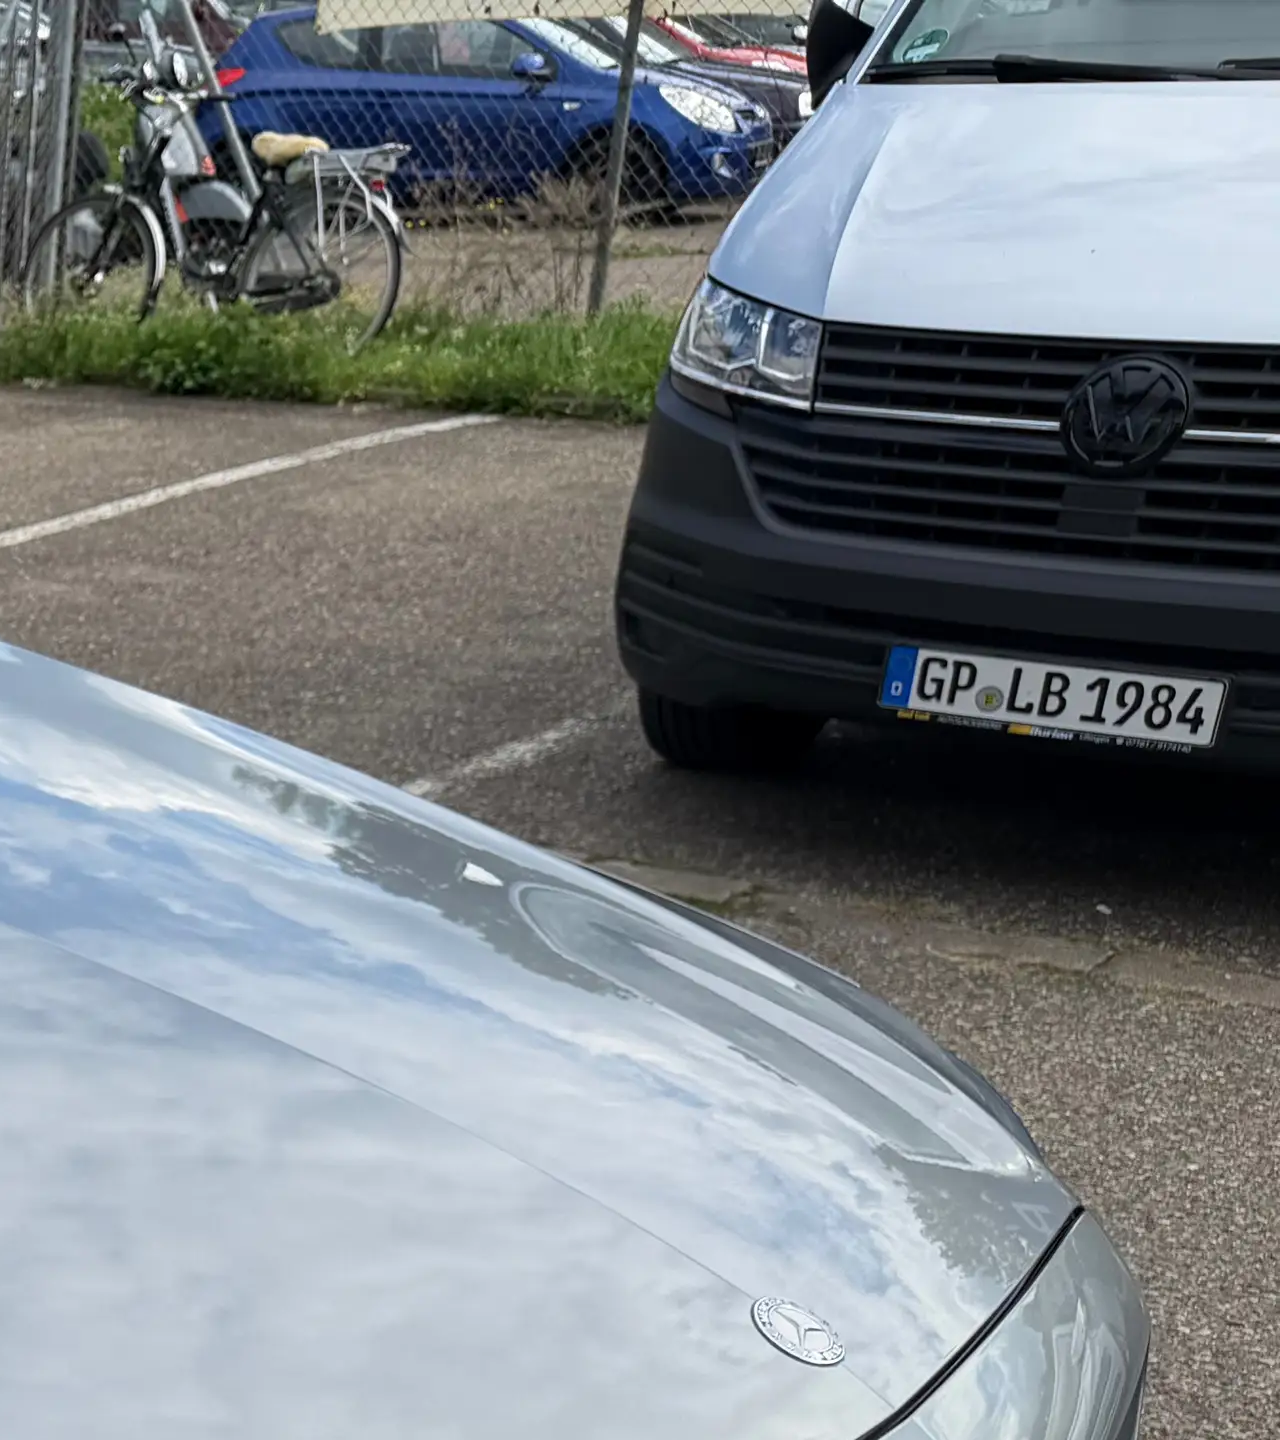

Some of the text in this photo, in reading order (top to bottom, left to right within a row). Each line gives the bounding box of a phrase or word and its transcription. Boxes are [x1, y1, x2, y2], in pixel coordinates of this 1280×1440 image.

[916, 656, 1205, 736] GP LB 1984
